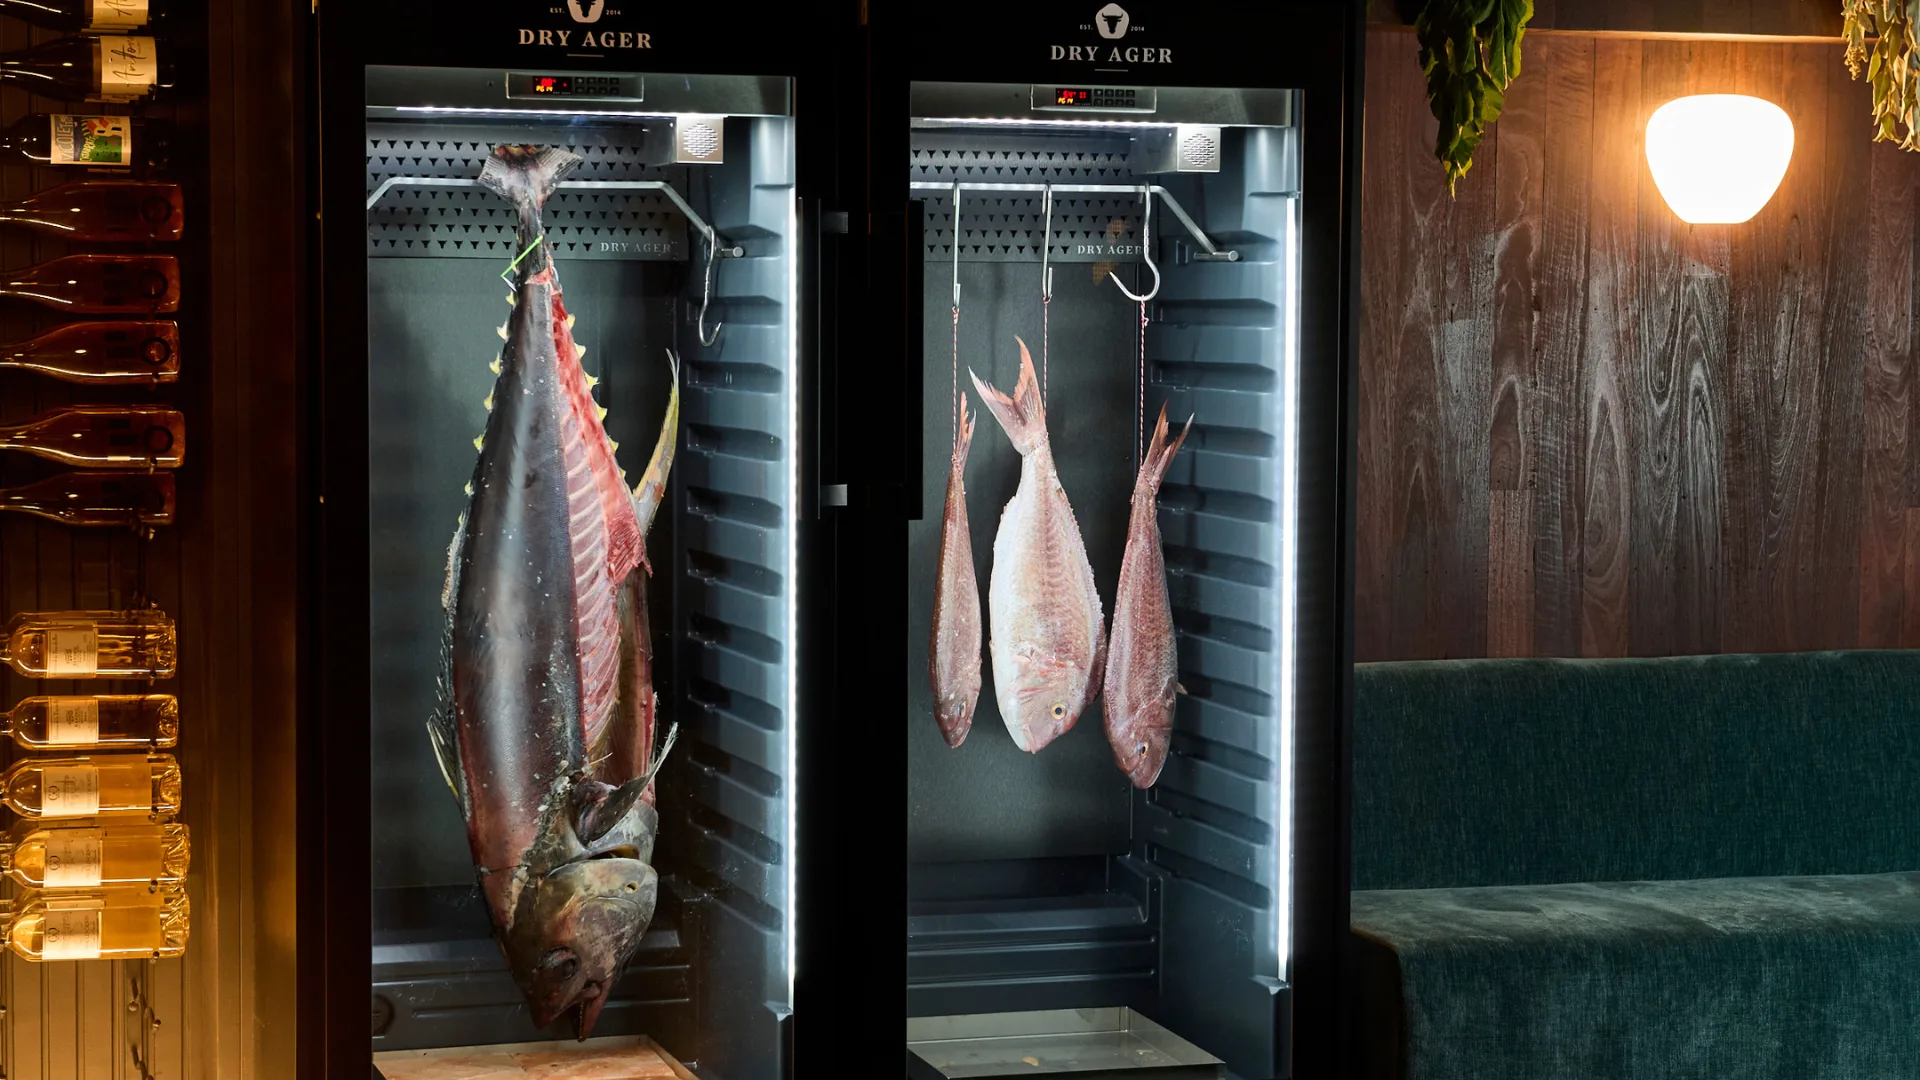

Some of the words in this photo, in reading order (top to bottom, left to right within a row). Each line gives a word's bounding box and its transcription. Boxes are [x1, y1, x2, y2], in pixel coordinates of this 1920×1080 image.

[519, 29, 572, 46] DRY
[582, 31, 652, 49] AGER
[1051, 45, 1099, 62] DRY
[1108, 47, 1173, 64] AGER
[600, 242, 629, 252] DRY
[634, 243, 672, 253] AGER
[1077, 245, 1104, 255] DRY
[1107, 245, 1143, 255] AGER
